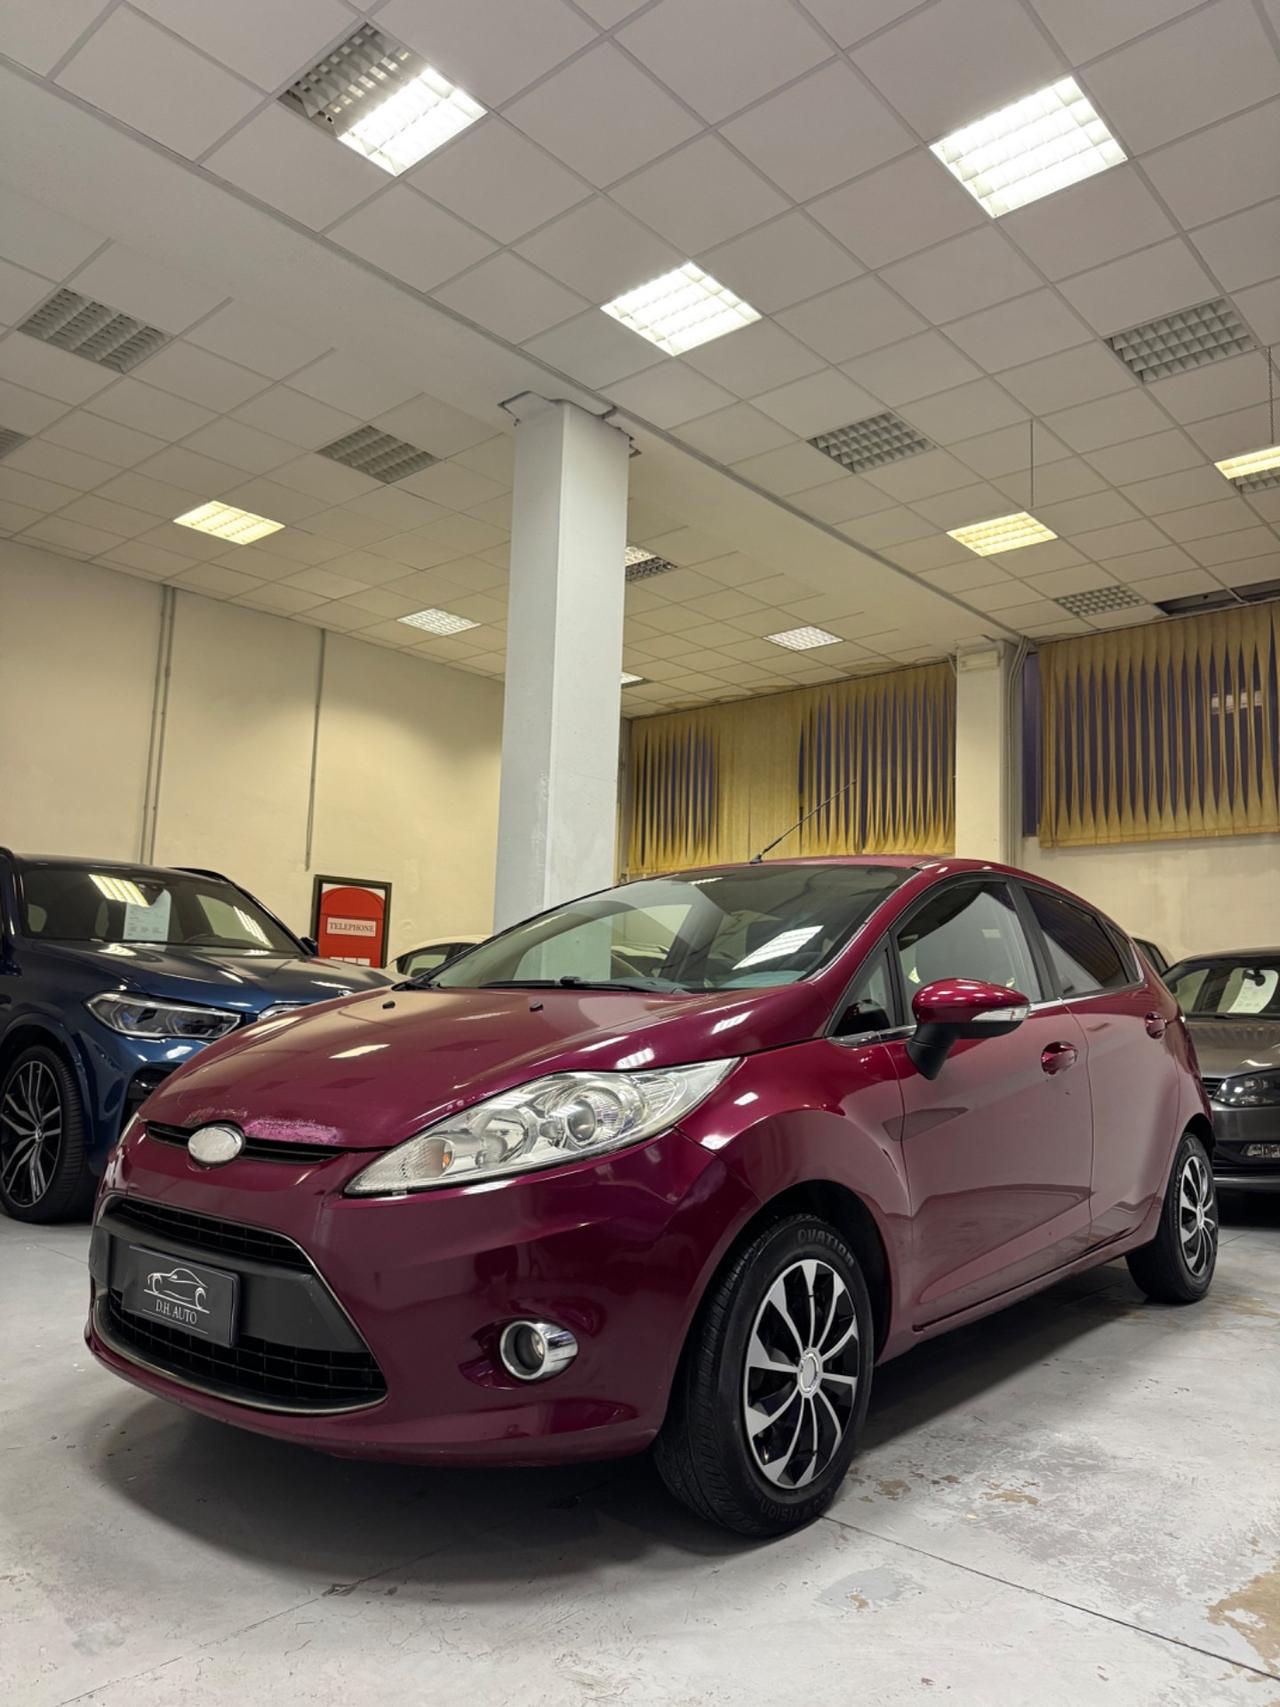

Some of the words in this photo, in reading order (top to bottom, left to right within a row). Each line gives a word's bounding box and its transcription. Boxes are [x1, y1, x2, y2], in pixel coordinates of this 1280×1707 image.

[329, 921, 375, 933] TELEPHONE
[155, 1299, 171, 1316] D.H.
[172, 1306, 197, 1325] AUTO
